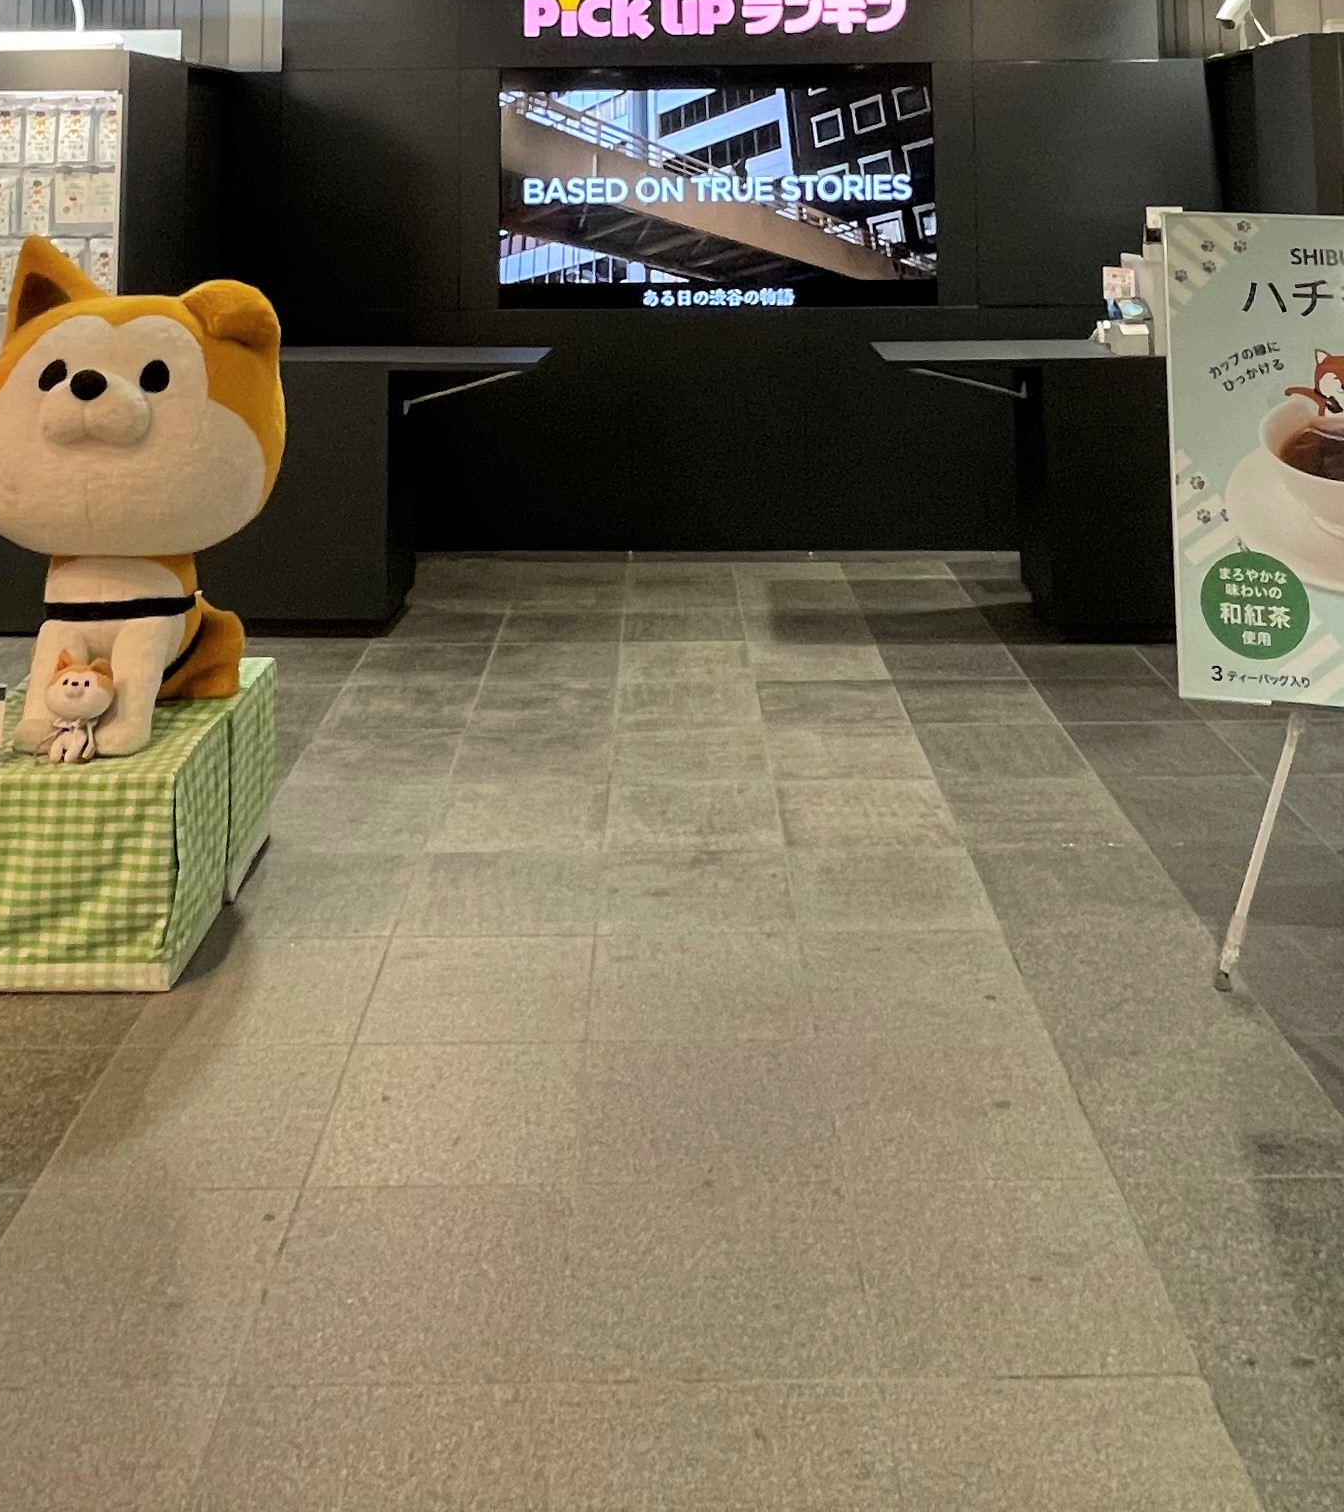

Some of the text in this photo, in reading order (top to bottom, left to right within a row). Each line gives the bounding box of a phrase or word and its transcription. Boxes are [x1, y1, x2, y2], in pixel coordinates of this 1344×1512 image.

[523, 174, 913, 205] BASED ON TRUE STORIES
[642, 288, 796, 306] ある日の渋谷の物語
[1222, 358, 1284, 391] ひっかける
[1219, 567, 1287, 584] まろやかな
[1225, 583, 1282, 599] 味わいの
[1219, 602, 1291, 629] 和紅茶
